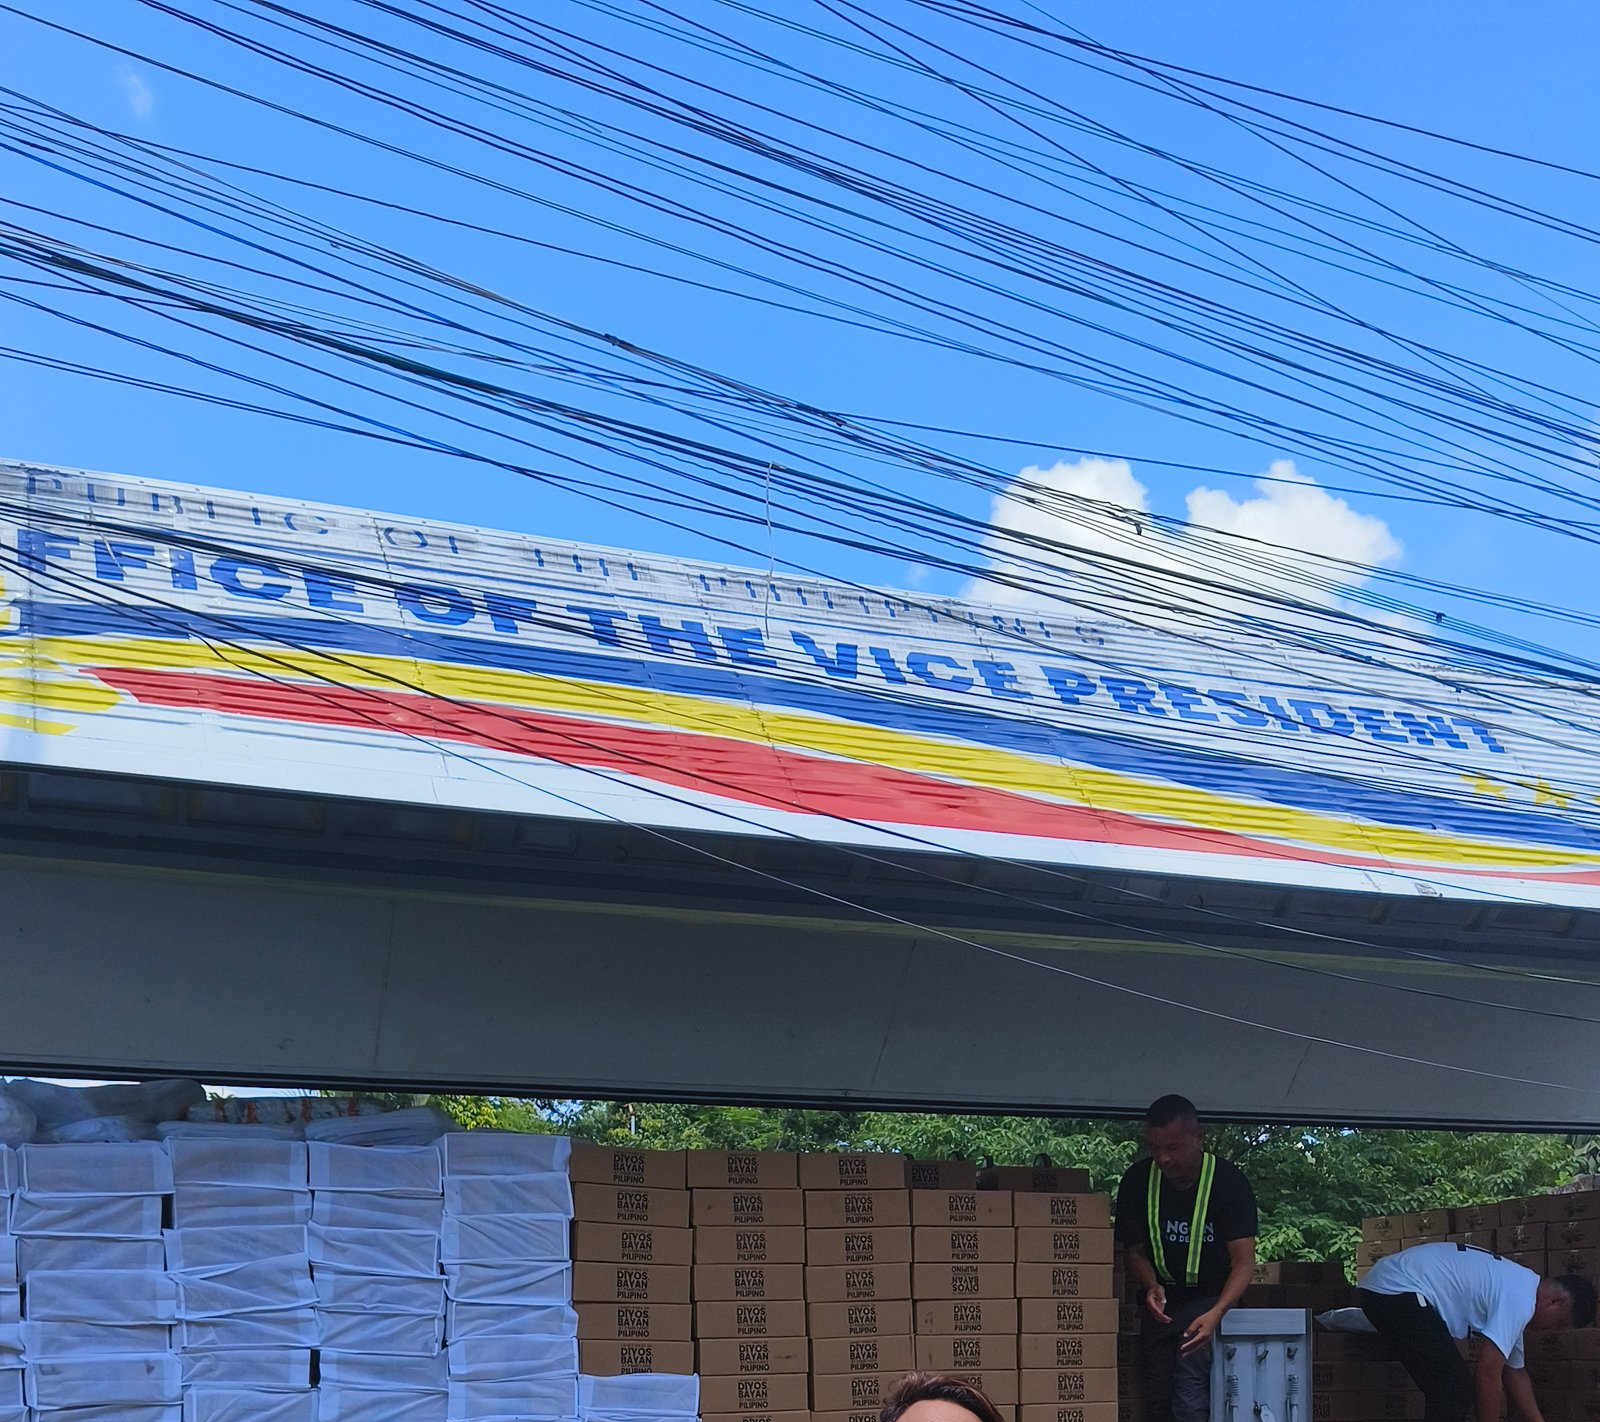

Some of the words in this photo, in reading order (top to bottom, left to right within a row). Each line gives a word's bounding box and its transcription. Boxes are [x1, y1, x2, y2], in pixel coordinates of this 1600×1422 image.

[395, 582, 537, 634] OF
[567, 605, 778, 668] THE
[790, 629, 1034, 701] VICE
[1040, 664, 1508, 754] PRESIDENT
[613, 1162, 644, 1172] BAYAN
[728, 1165, 757, 1174] BAYAN
[839, 1166, 867, 1175] BAYAN
[614, 1175, 644, 1184] PILIPINO
[728, 1176, 758, 1184] PILIPINO
[617, 1201, 648, 1210] BAYAN
[734, 1204, 763, 1213] BAYAN
[845, 1204, 873, 1213] BAYAN
[949, 1203, 976, 1211] BAYAN
[1051, 1207, 1077, 1215] BAYAN
[617, 1213, 648, 1222] PILIPINO
[734, 1215, 763, 1223] PILIPINO
[846, 1215, 873, 1223] PILIPINO
[950, 1214, 976, 1222] PILIPINO
[622, 1241, 652, 1250] BAYAN
[737, 1242, 766, 1250] BAYAN
[845, 1243, 873, 1251] BAYAN
[952, 1241, 978, 1249] BAYAN
[1054, 1242, 1079, 1250] BAYAN
[622, 1252, 652, 1261] PILIPINO
[737, 1253, 766, 1261] PILIPINO
[846, 1254, 874, 1262] PILIPINO
[617, 1279, 647, 1288] BAYAN
[735, 1278, 764, 1287] BAYAN
[846, 1279, 874, 1288] BAYAN
[1053, 1278, 1078, 1286] BAYAN
[617, 1291, 648, 1299] PILIPINO
[847, 1290, 875, 1298] PILIPINO
[737, 1315, 766, 1324] BAYAN
[849, 1315, 876, 1324] BAYAN
[954, 1313, 981, 1321] BAYAN
[1057, 1313, 1083, 1321] BAYAN
[618, 1318, 649, 1326] BAYAN
[618, 1330, 649, 1338] PILIPINO
[849, 1326, 877, 1334] PILIPINO
[850, 1351, 877, 1360] BAYAN
[953, 1349, 981, 1357] BAYAN
[1057, 1348, 1082, 1356] BAYAN
[621, 1356, 652, 1364] BAYAN
[739, 1352, 768, 1361] BAYAN
[740, 1363, 769, 1372] PILIPINO
[851, 1362, 878, 1370] PILIPINO
[1058, 1382, 1084, 1390] BAYAN
[739, 1389, 767, 1398] BAYAN
[852, 1388, 879, 1396] BAYAN
[739, 1400, 768, 1408] PILIPINO
[853, 1398, 880, 1406] PILIPINO
